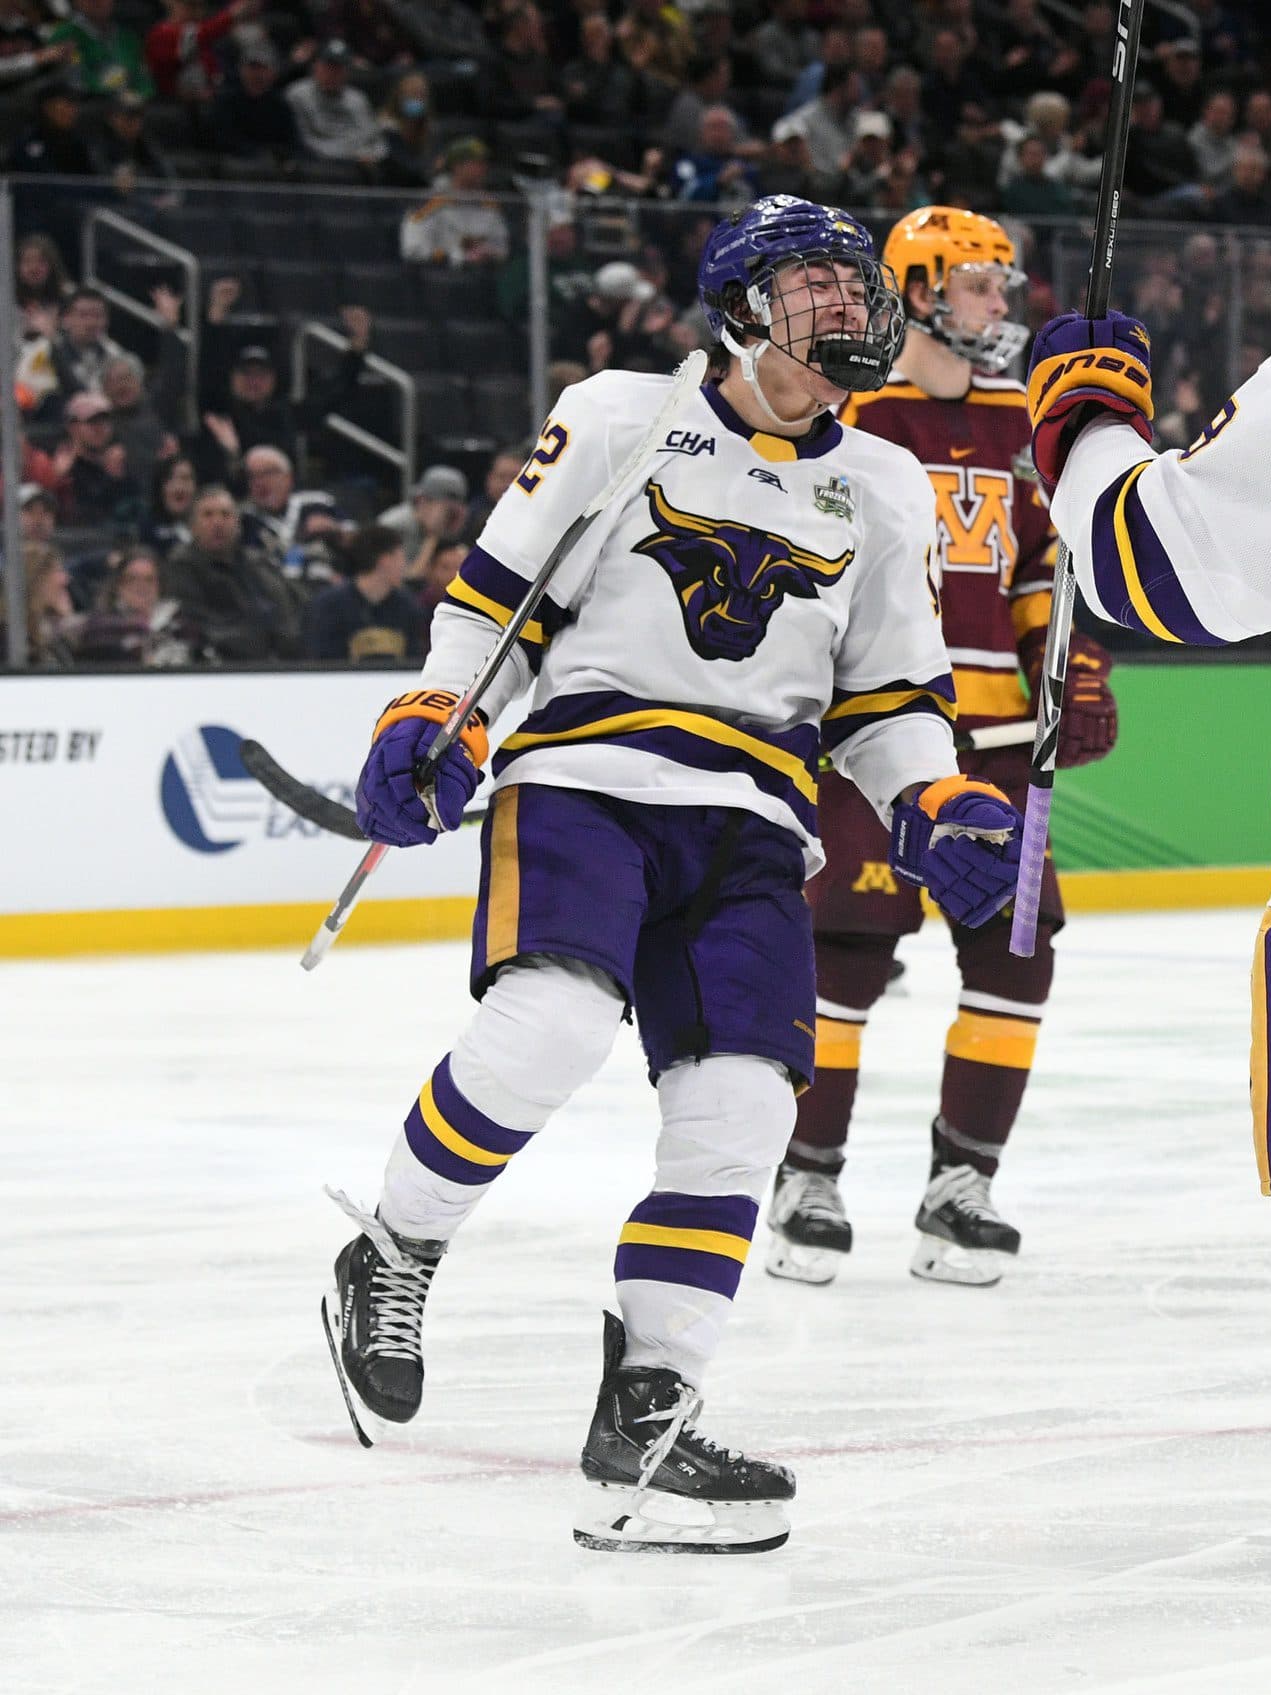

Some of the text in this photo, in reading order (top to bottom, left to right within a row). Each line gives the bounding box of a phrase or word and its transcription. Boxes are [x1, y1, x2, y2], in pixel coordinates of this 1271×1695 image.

[513, 416, 571, 498] 2
[665, 430, 716, 456] CHA
[67, 730, 104, 763] BY
[851, 861, 899, 895] M
